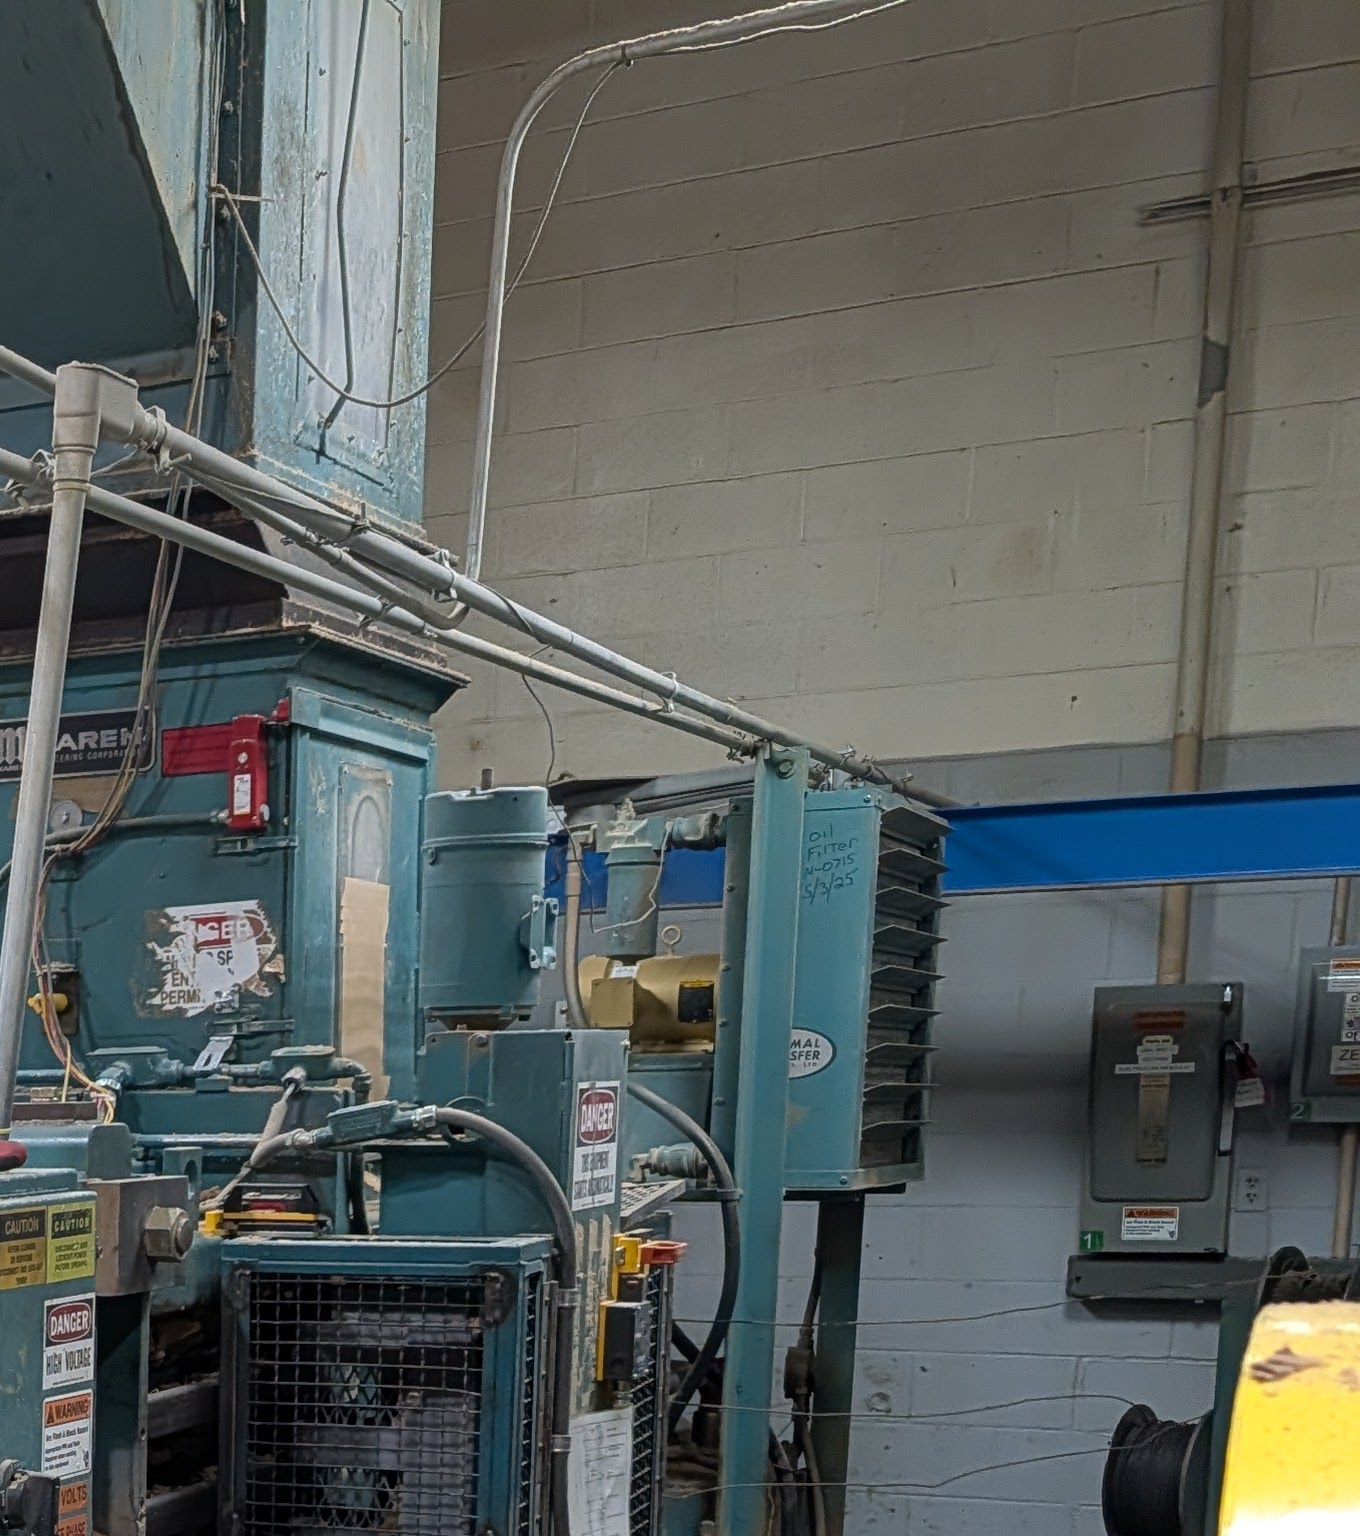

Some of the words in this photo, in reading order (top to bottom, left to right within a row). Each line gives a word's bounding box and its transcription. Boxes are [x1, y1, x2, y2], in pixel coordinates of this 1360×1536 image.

[580, 1102, 614, 1133] DANGER
[1290, 1103, 1305, 1119] 2
[5, 1216, 39, 1235] CAUTION
[54, 1216, 90, 1231] CAUTION
[1083, 1233, 1092, 1249] 1
[50, 1310, 89, 1337] DANGER
[46, 1352, 62, 1376] HIGH
[64, 1347, 91, 1371] VOLTAGE
[55, 1398, 89, 1419] WARNING
[61, 1484, 87, 1506] VOLTS
